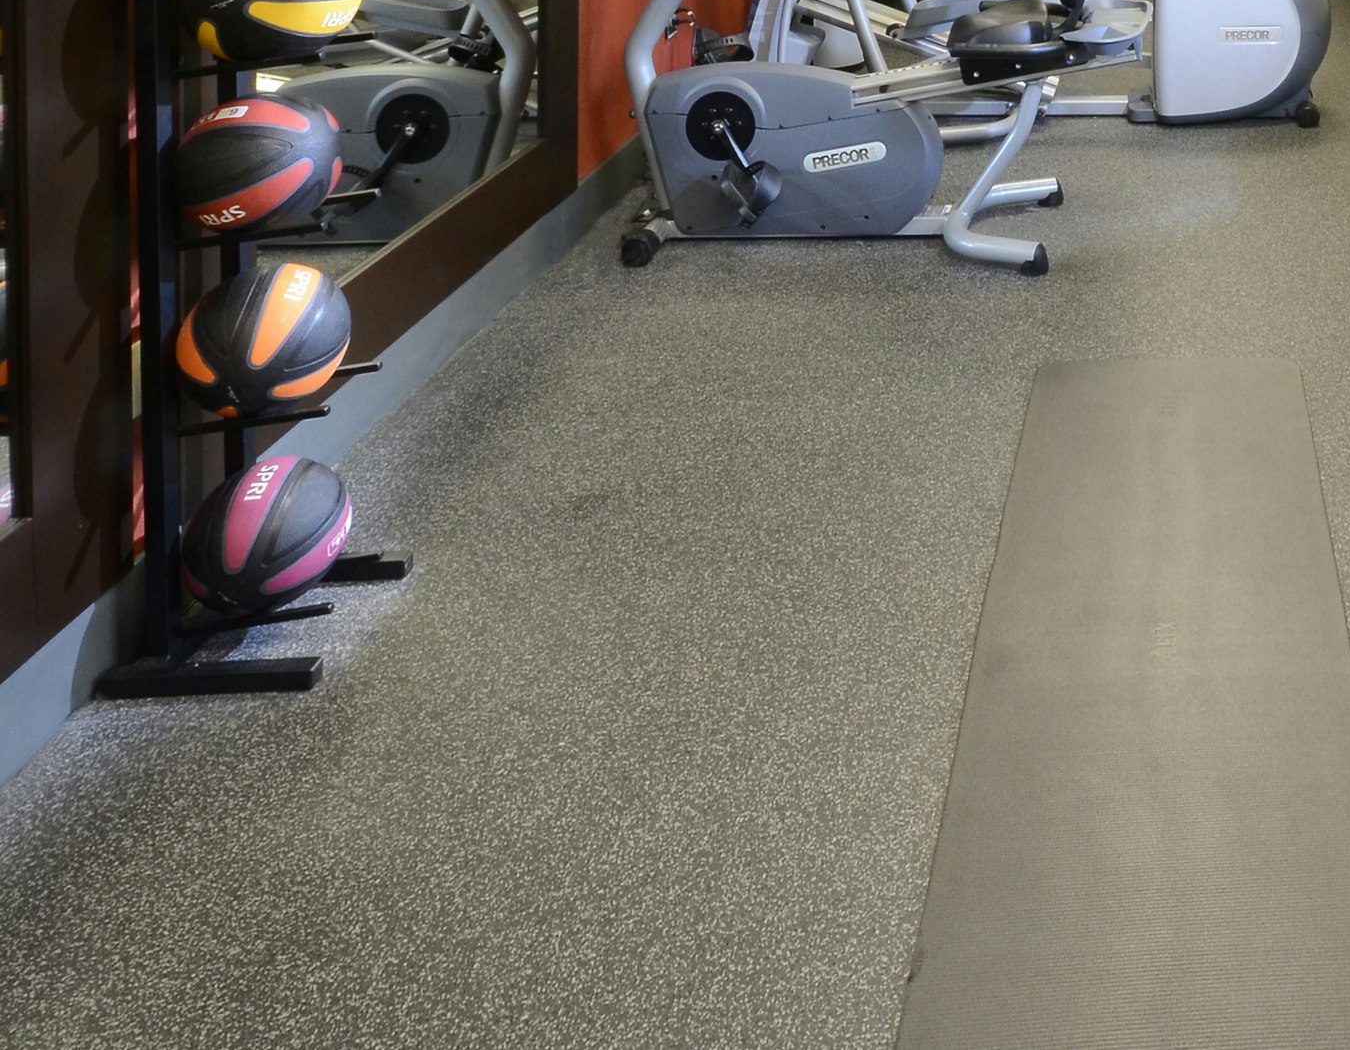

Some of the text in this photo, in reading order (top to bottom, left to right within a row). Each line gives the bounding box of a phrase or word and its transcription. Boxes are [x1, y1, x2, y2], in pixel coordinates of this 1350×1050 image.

[1225, 30, 1270, 40] PRECOR
[812, 148, 870, 170] PRECOR
[200, 205, 247, 226] SPRI
[283, 269, 312, 302] SPRI
[244, 464, 280, 501] SPRI
